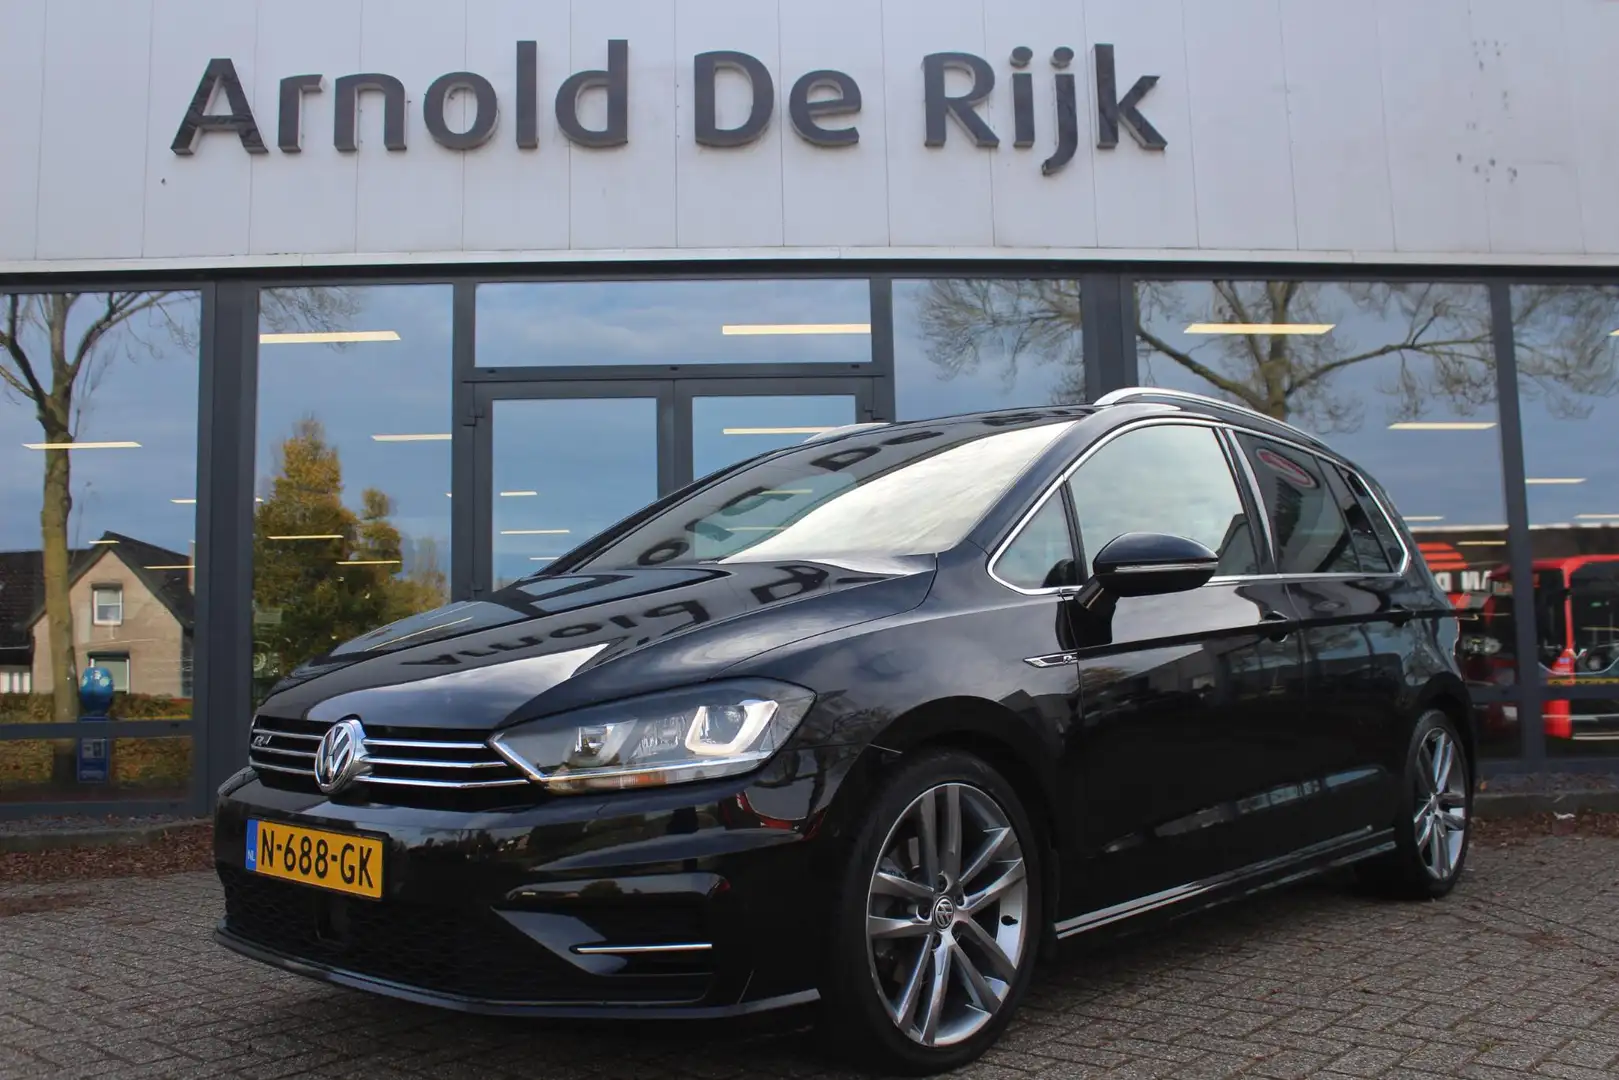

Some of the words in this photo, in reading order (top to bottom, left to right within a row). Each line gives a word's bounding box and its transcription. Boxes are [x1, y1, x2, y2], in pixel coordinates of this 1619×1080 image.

[171, 39, 629, 156] Arnold
[694, 50, 862, 148] De
[921, 43, 1167, 176] Rijk
[247, 850, 256, 862] NL
[261, 828, 374, 889] N-688-GK
